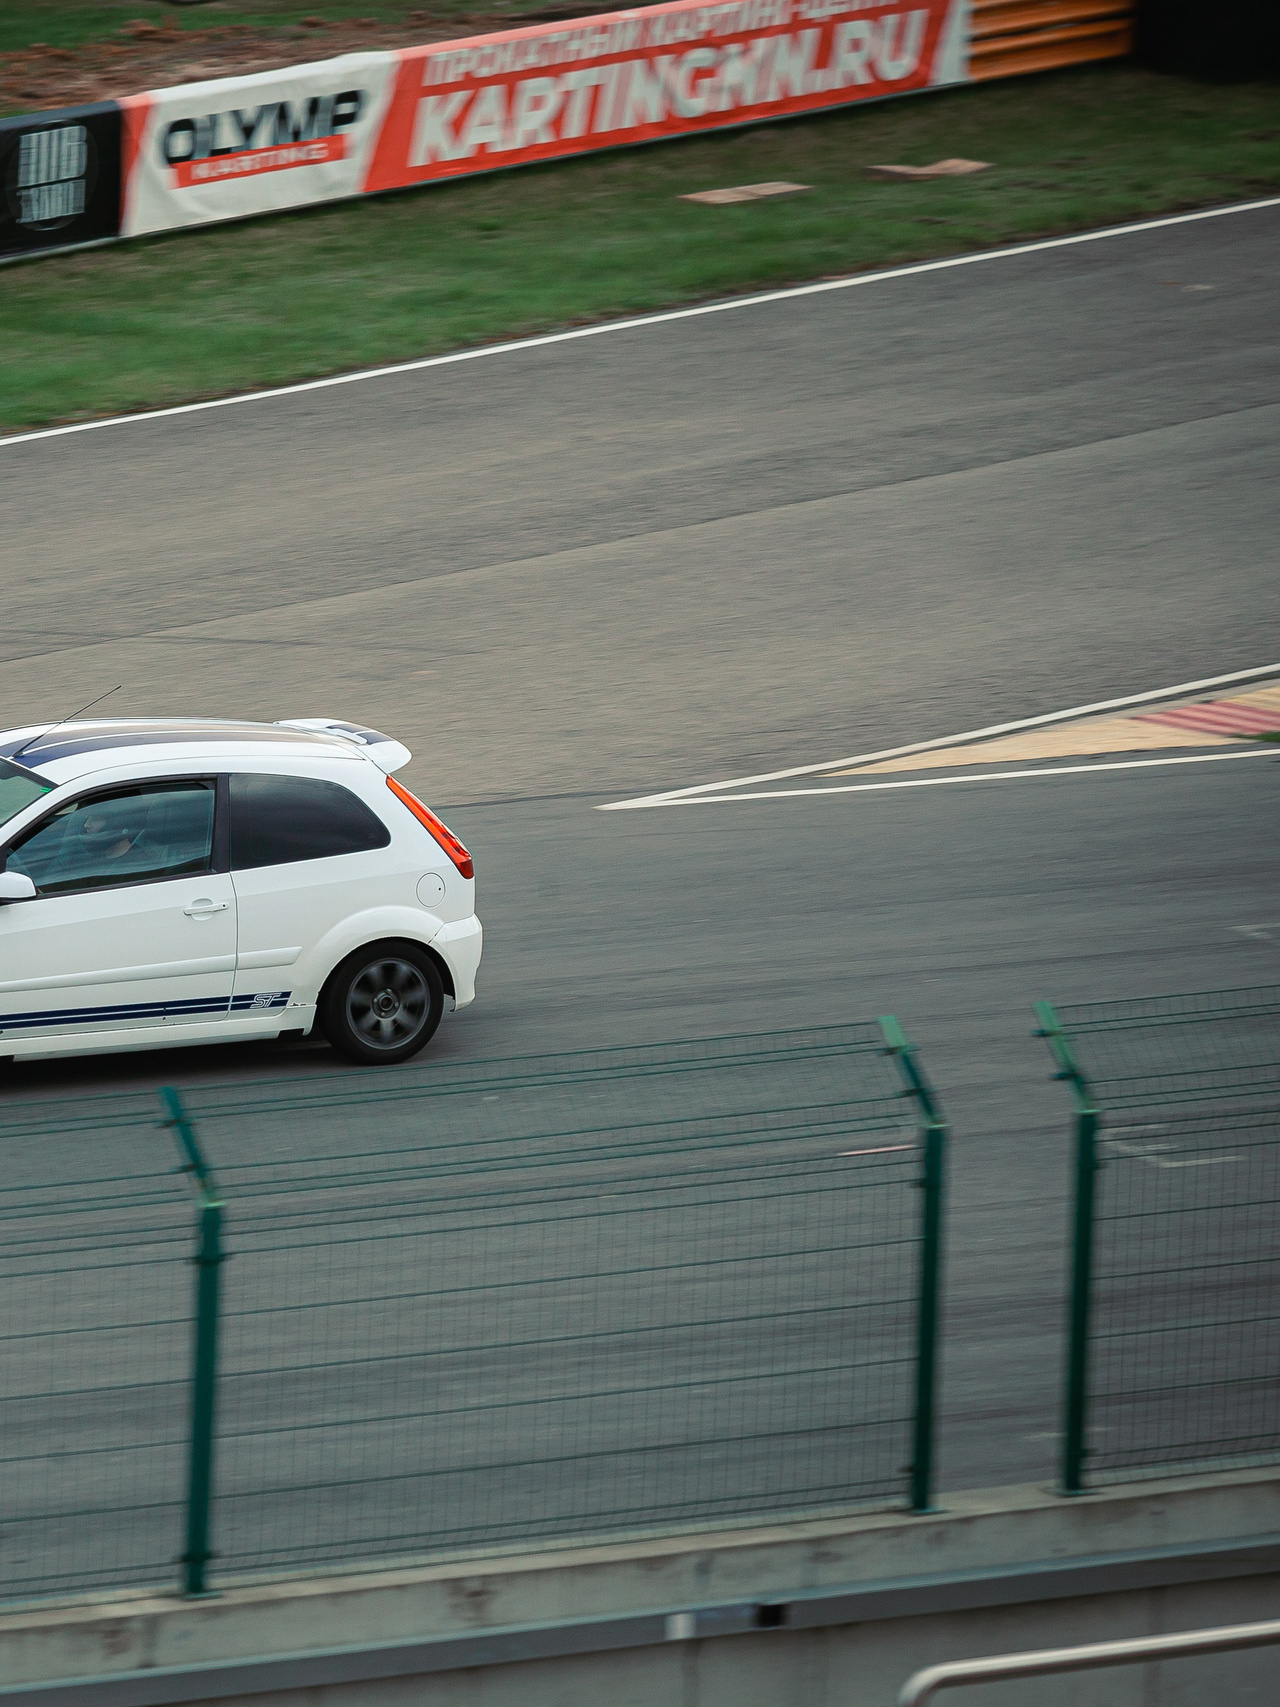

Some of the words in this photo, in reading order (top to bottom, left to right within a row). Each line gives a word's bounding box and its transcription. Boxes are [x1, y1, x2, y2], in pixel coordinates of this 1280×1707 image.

[163, 89, 367, 168] OLYMP
[189, 143, 330, 181] KARTING
[250, 992, 282, 1009] ST
